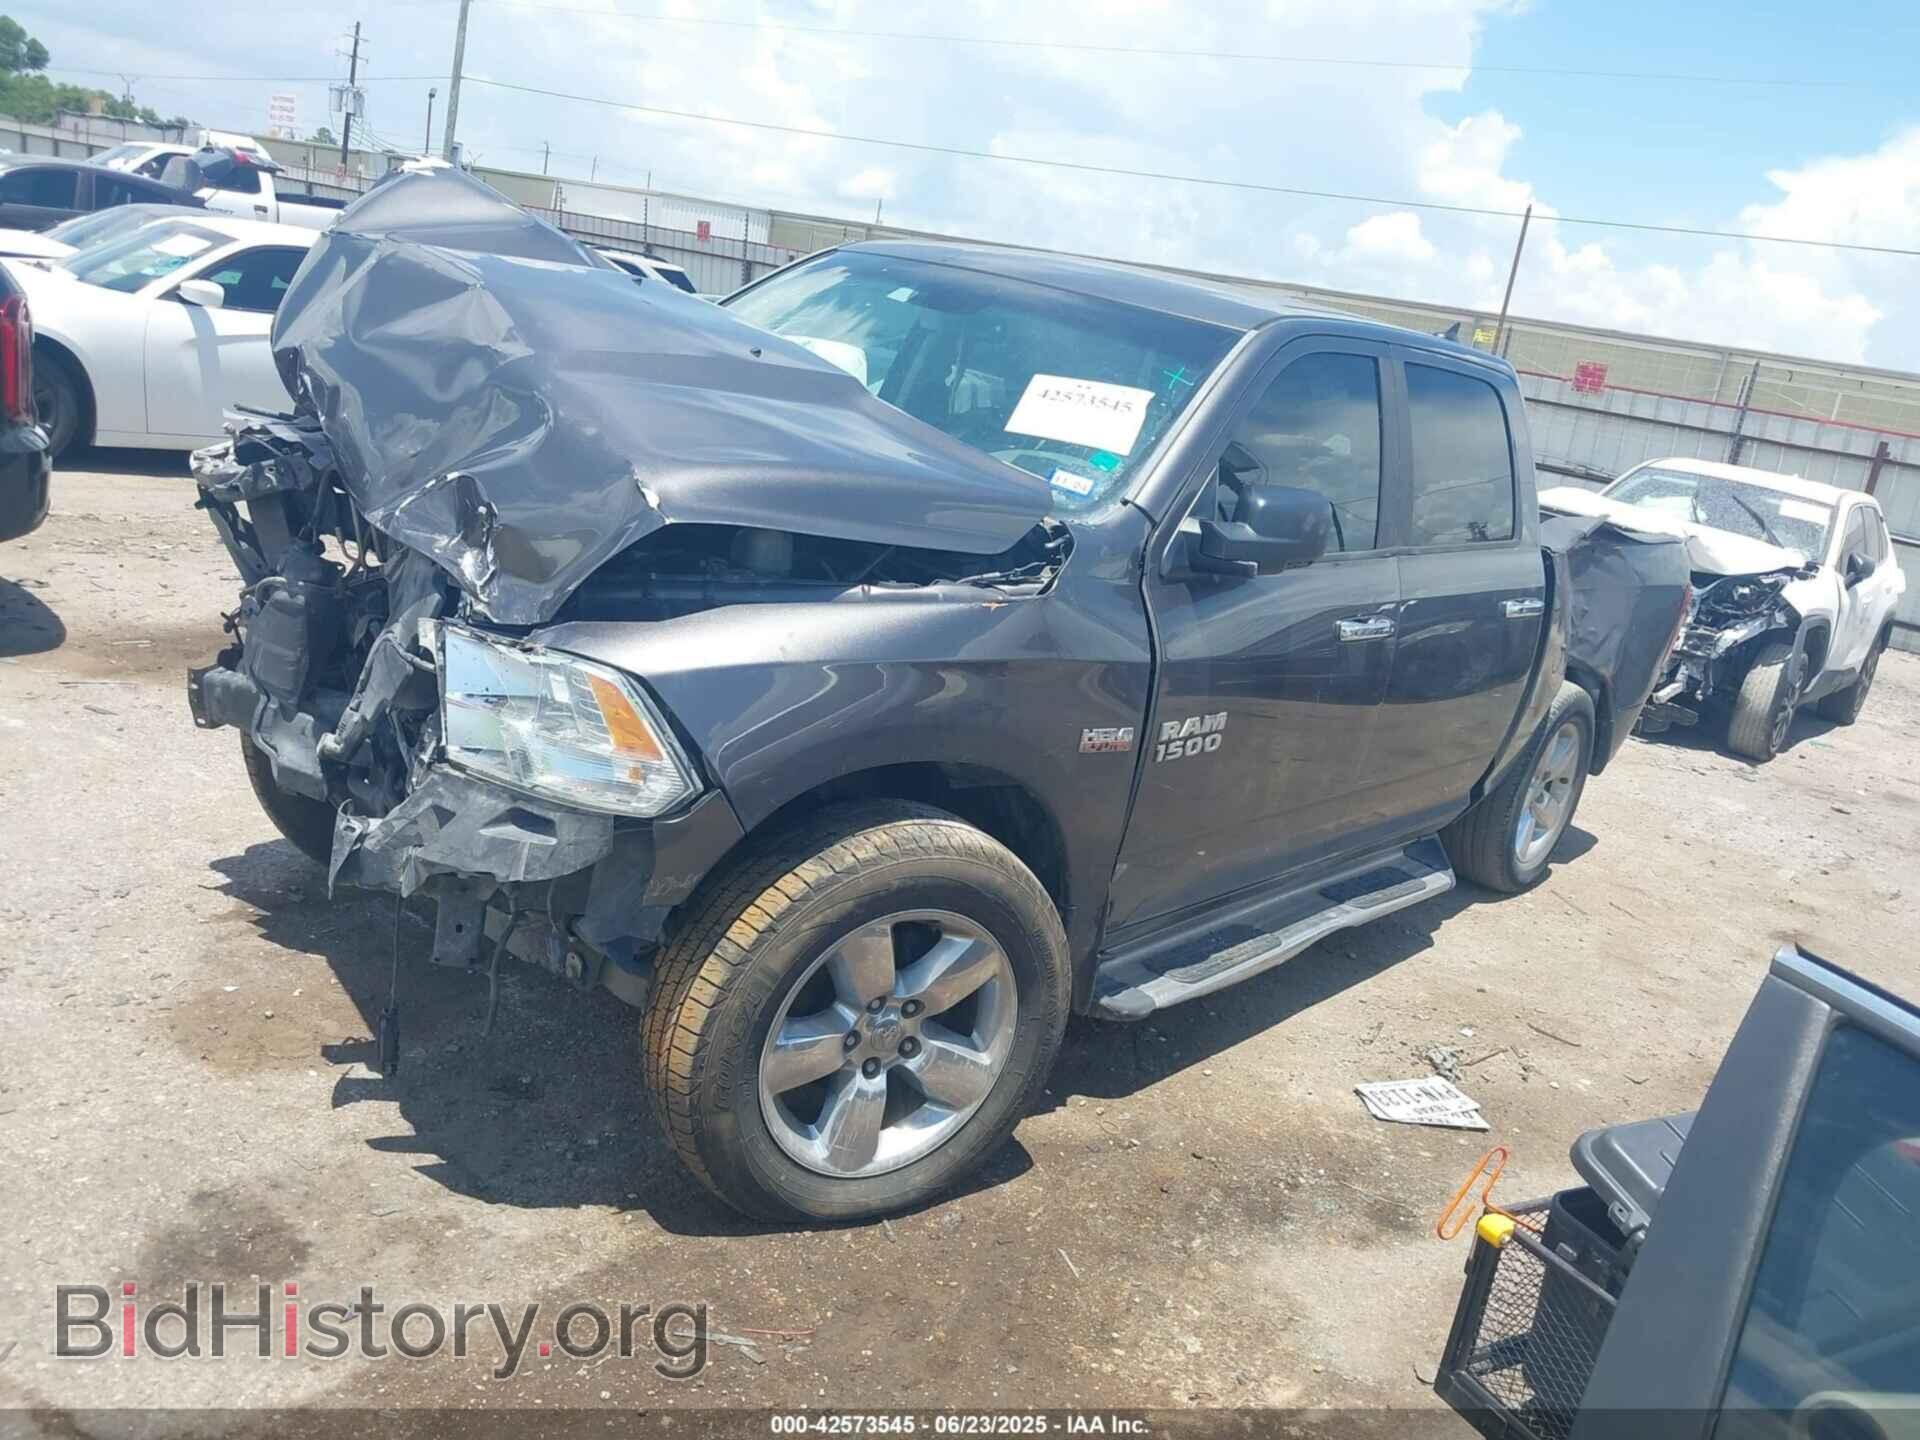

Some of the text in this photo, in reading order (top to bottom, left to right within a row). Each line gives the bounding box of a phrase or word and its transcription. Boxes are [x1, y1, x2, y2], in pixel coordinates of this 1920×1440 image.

[1082, 727, 1134, 743] HEMI
[1158, 711, 1228, 741] RAM
[1155, 733, 1222, 763] 1500
